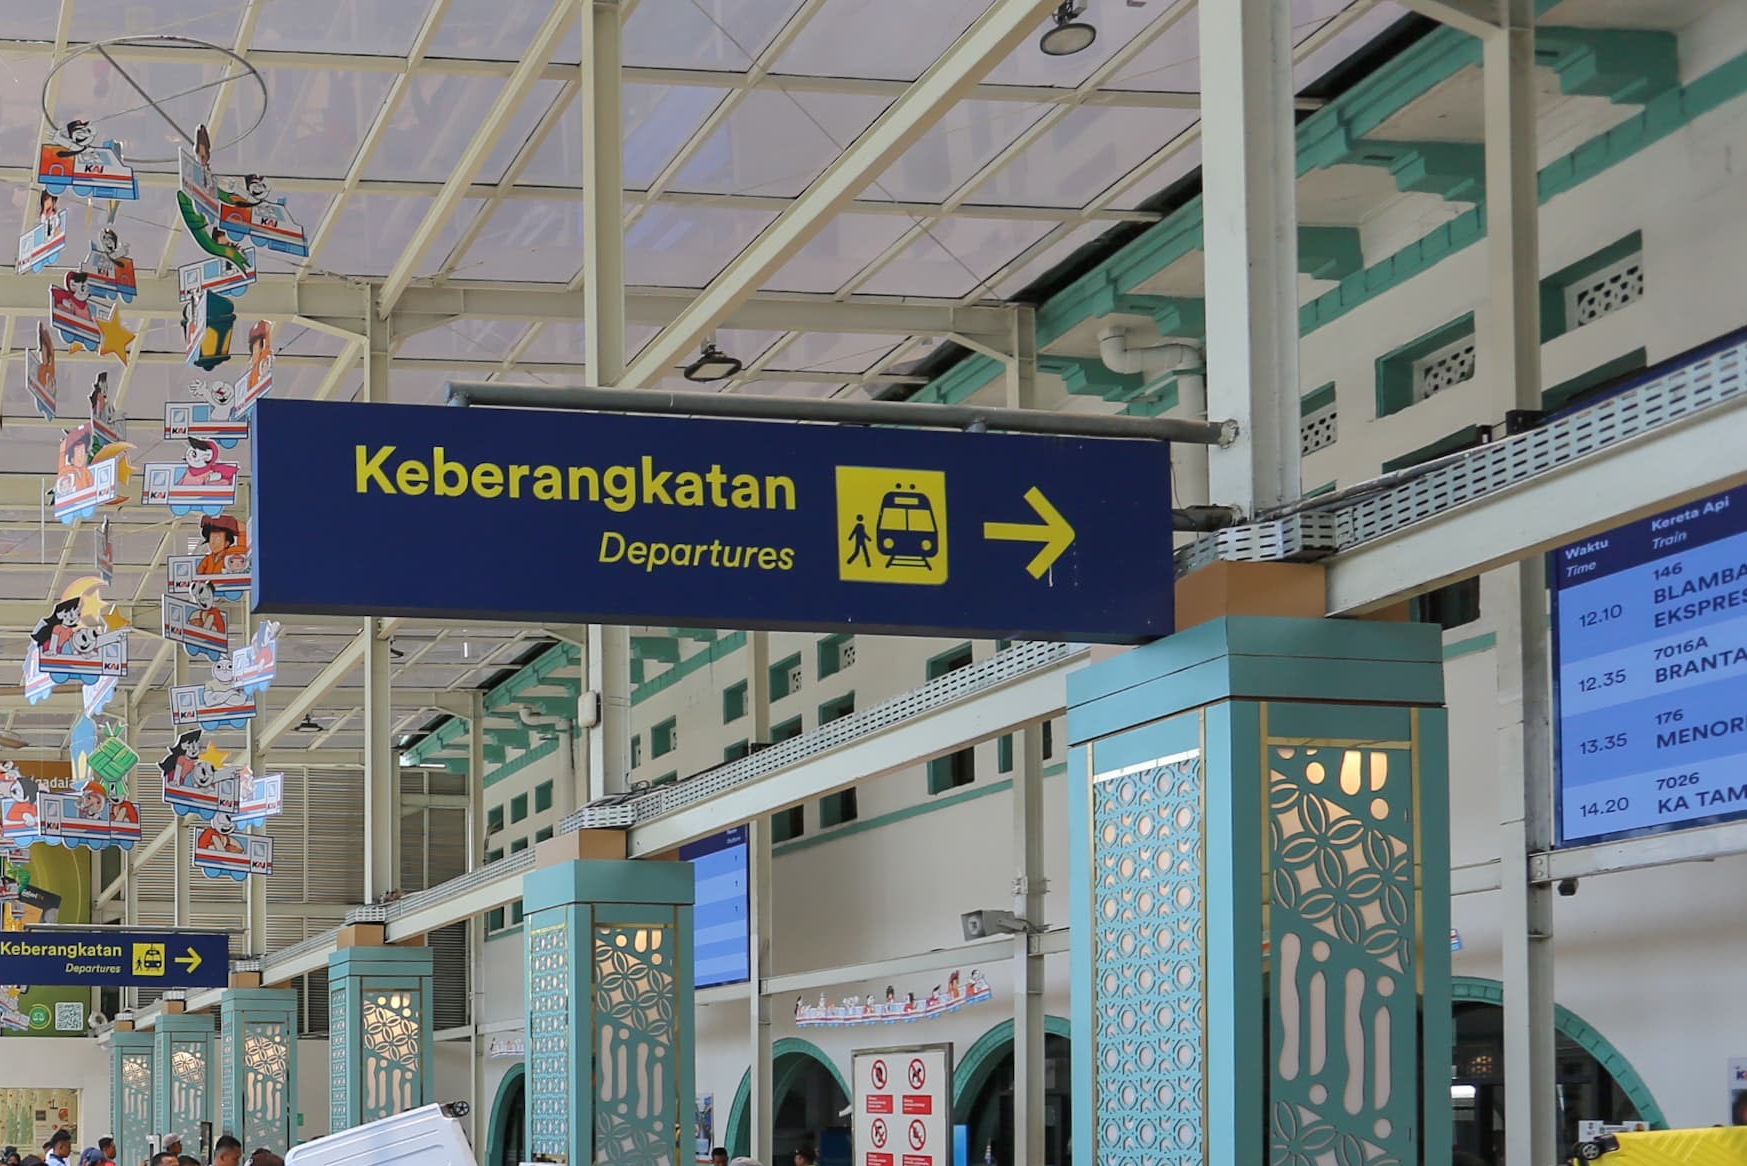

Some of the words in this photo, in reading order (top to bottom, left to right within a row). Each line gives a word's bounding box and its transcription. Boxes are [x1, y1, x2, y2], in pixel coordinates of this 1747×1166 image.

[85, 164, 103, 173] KAI
[261, 218, 278, 227] KAI
[172, 426, 186, 434] KAI
[354, 445, 797, 513] Keberangkatan
[150, 491, 166, 499] KAI
[1651, 506, 1700, 531] Kereta
[1703, 496, 1730, 517] Api
[1565, 538, 1609, 560] Waktu
[1651, 530, 1688, 549] Train
[598, 531, 795, 571] Departures
[1566, 560, 1597, 578] Time
[1654, 562, 1683, 581] 146
[1579, 604, 1622, 628] 12.10
[1654, 636, 1708, 661] 7016A
[104, 662, 120, 670] KAI
[1655, 647, 1747, 684] BRANTA
[1579, 669, 1626, 692] 12.35
[180, 711, 195, 719] KAI
[1655, 708, 1684, 727] 176
[1656, 714, 1747, 749] MENOR
[1580, 733, 1628, 755] 13.35
[1656, 771, 1700, 790] 7026
[219, 799, 233, 808] KAI
[1580, 797, 1629, 818] 14.20
[1658, 796, 1688, 815] KA
[1695, 784, 1747, 809] TAM
[252, 861, 266, 869] KAI
[0, 941, 122, 959] Keberangkatan
[65, 962, 122, 974] Departures
